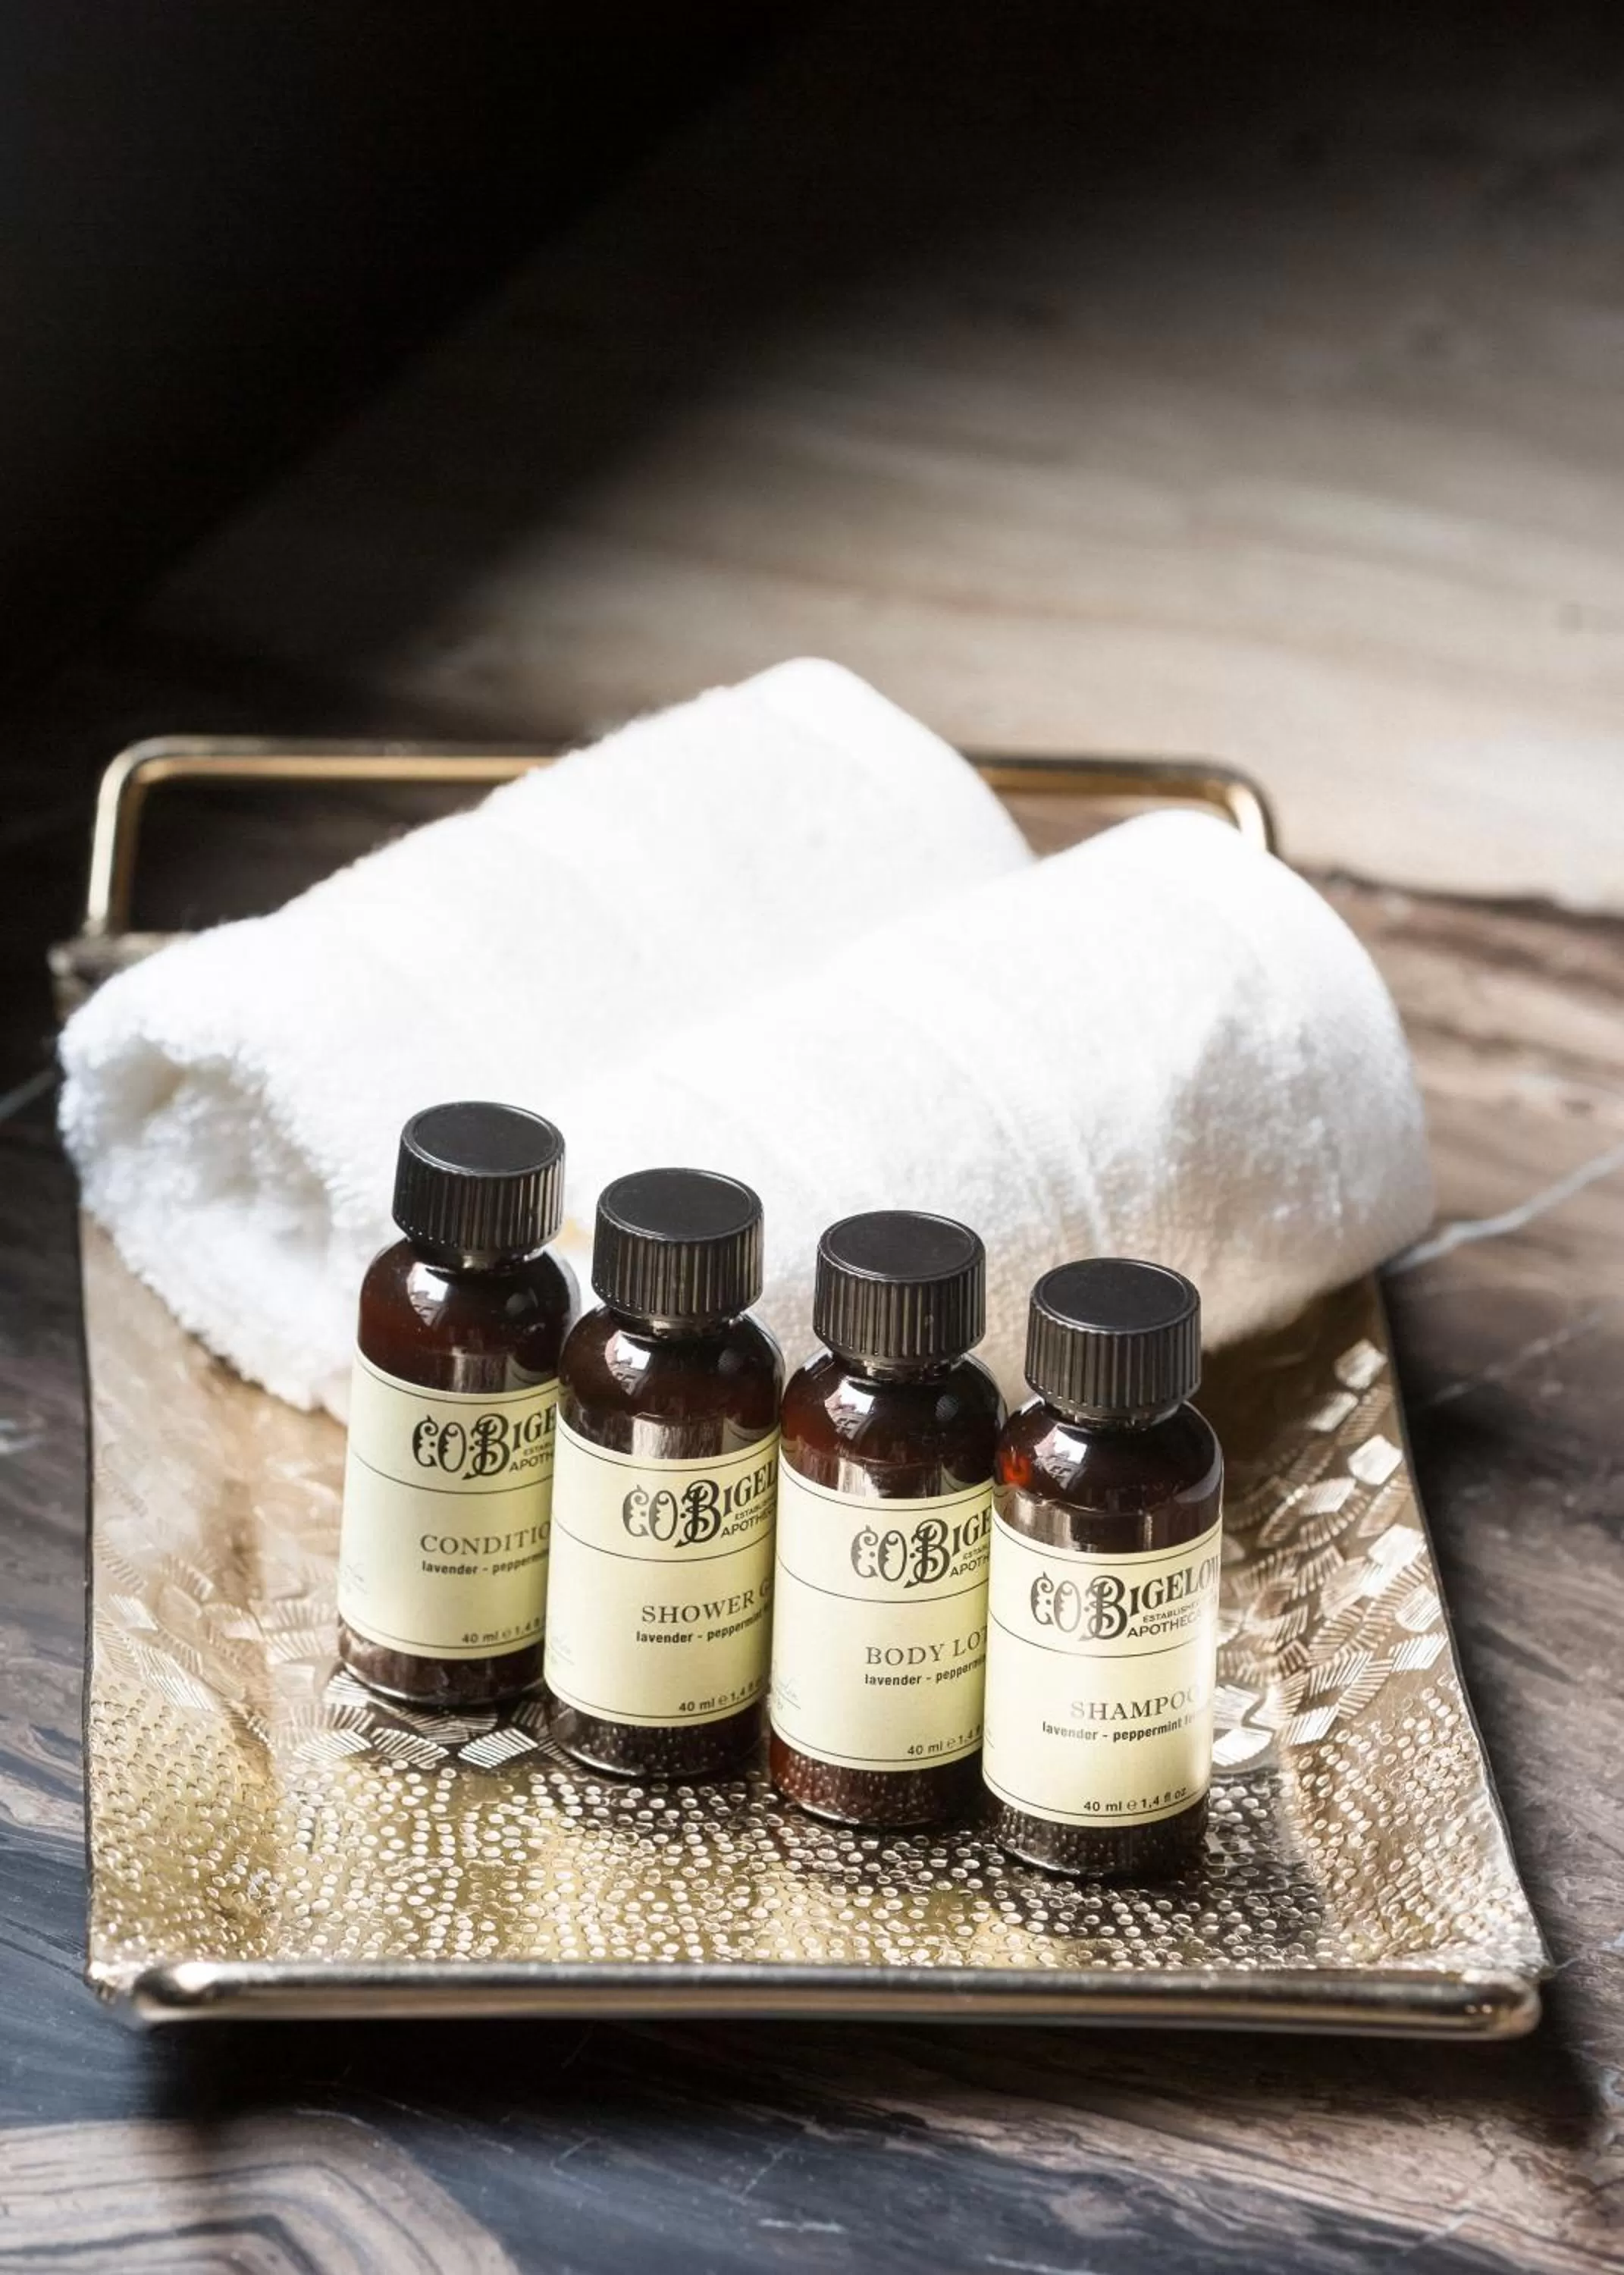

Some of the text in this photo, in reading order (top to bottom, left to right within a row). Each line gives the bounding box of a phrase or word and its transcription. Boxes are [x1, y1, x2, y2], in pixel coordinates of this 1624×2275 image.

[422, 1560, 478, 1575] lavender
[641, 1589, 754, 1624] SHOWER
[462, 1633, 478, 1644] 40
[636, 1631, 693, 1643] lavender
[866, 1644, 945, 1666] BODY
[865, 1674, 923, 1686] lavender
[679, 1701, 695, 1712] 40
[699, 1698, 715, 1710] ml
[1042, 1721, 1098, 1740] lavender
[1113, 1717, 1183, 1743] peppermint
[908, 1745, 923, 1756] 40
[928, 1741, 943, 1753] ml
[1083, 1801, 1100, 1811] 40
[1105, 1801, 1122, 1811] ml
[1175, 1787, 1187, 1799] oz
